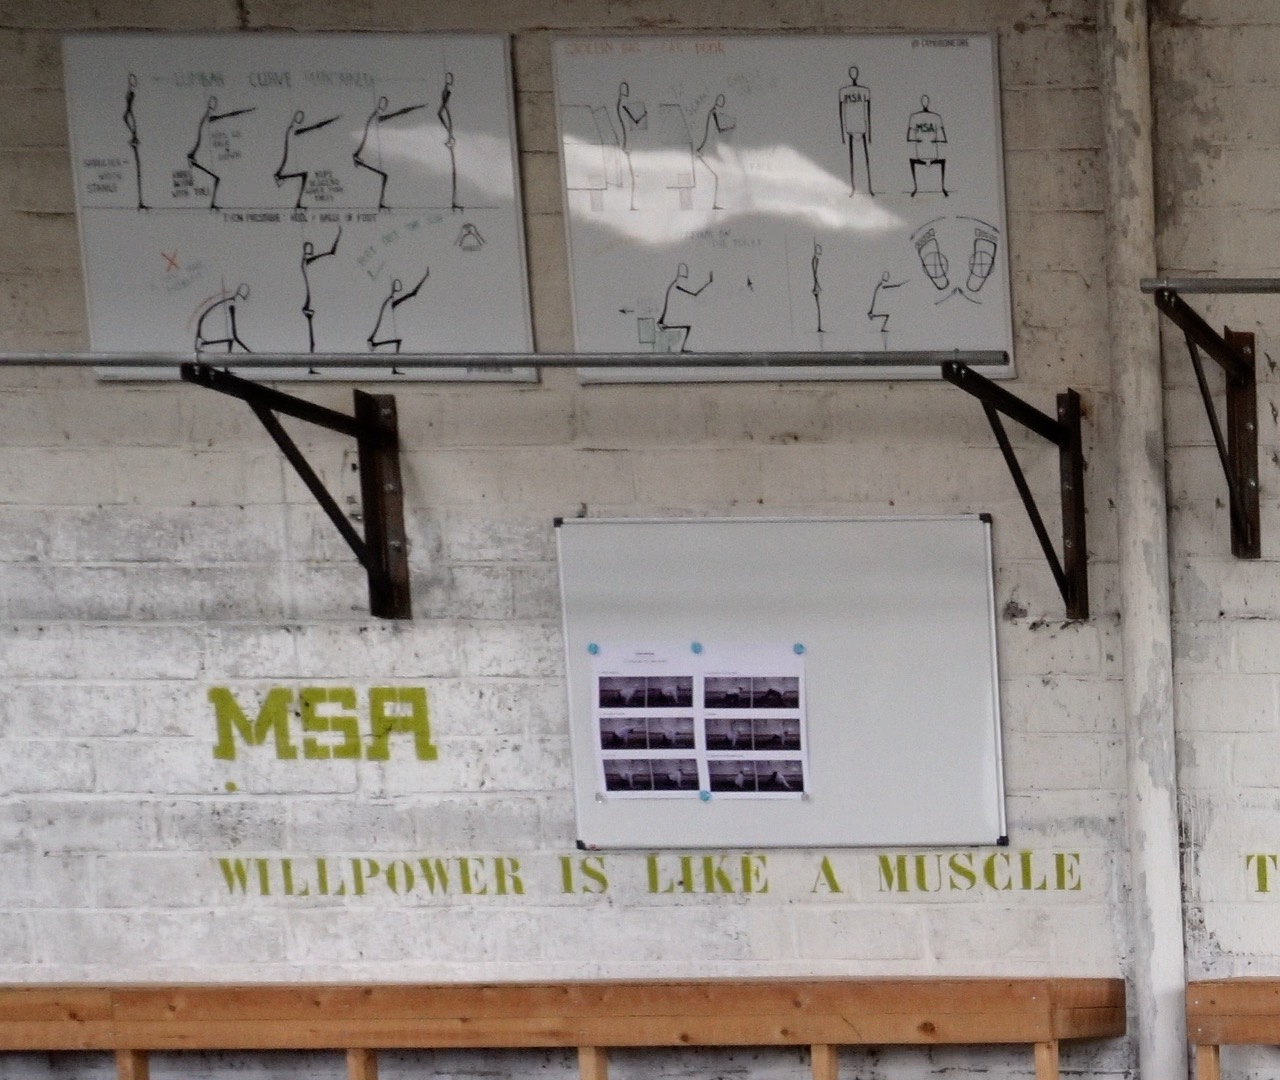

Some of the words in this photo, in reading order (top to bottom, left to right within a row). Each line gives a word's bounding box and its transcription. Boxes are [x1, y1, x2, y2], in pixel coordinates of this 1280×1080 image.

[915, 123, 935, 133] MSA
[206, 686, 440, 762] MSA
[216, 856, 526, 897] WILLPOWER
[558, 855, 610, 895] IS
[645, 853, 770, 894] LIKE
[811, 854, 845, 894] A
[877, 849, 1082, 893] MUSCLE
